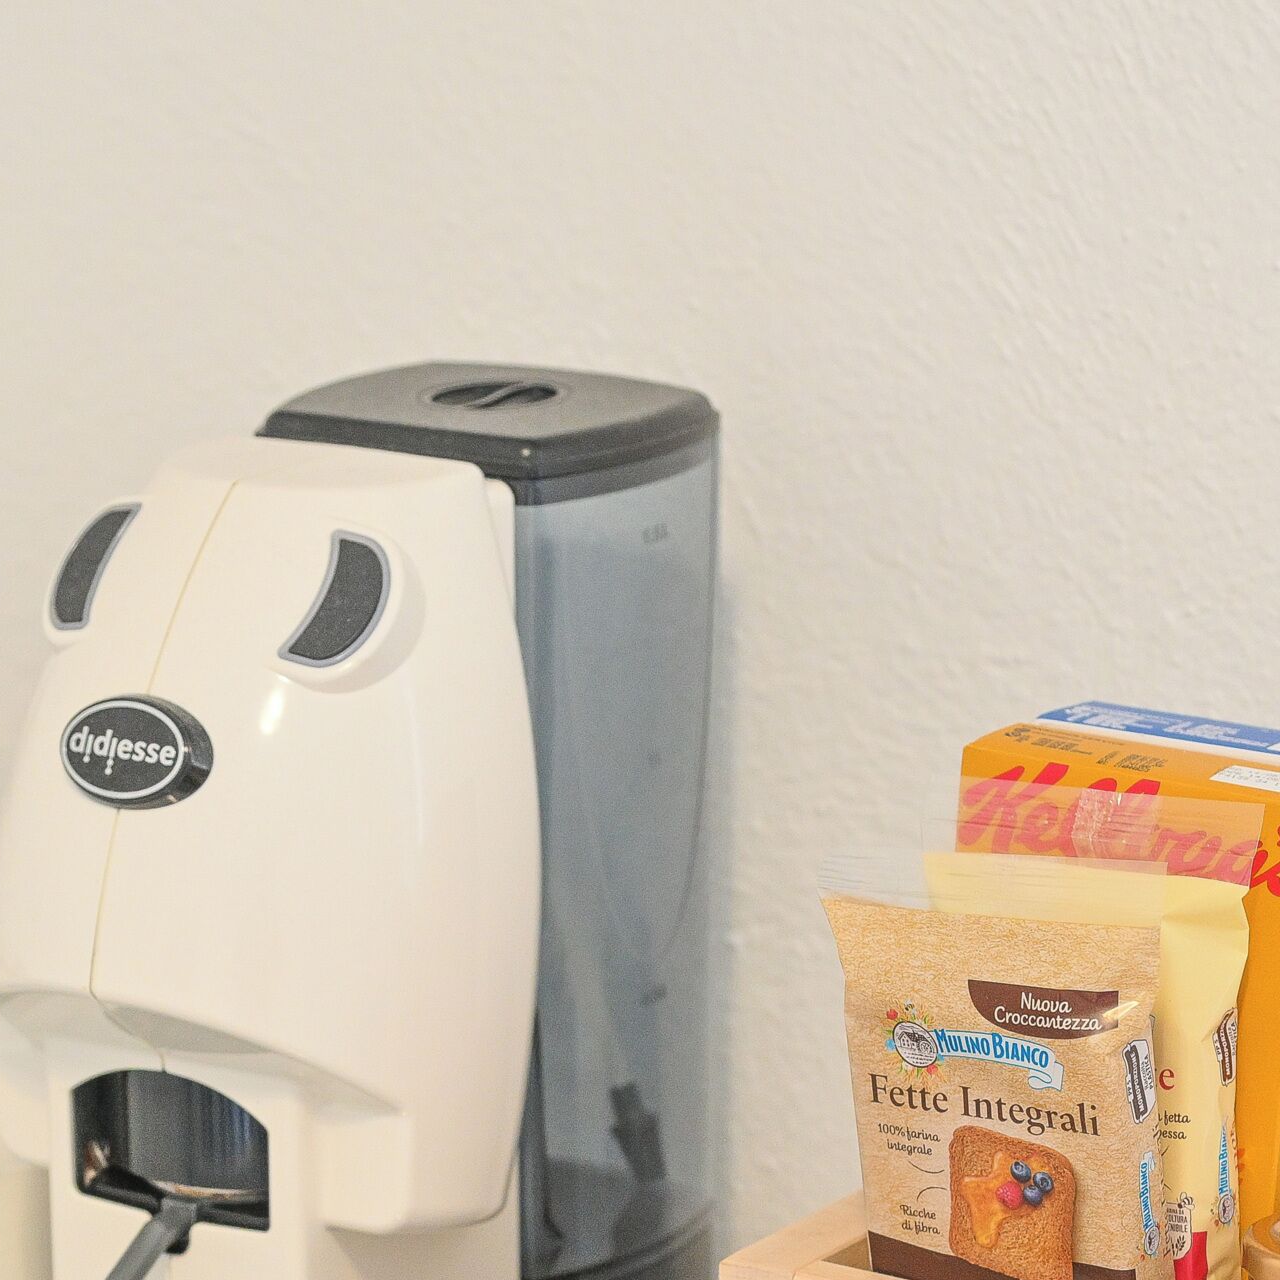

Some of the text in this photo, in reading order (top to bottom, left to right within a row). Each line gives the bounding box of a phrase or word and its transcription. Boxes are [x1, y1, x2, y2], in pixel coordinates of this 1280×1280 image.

[69, 725, 177, 776] didiesse
[1020, 991, 1073, 1014] Nuova
[993, 1006, 1104, 1031] Croccantezza
[933, 1028, 1050, 1069] MULINO BIANCO
[868, 1073, 1101, 1137] Fette Integrali
[878, 1123, 942, 1142] 100% farina
[887, 1139, 933, 1156] integrale
[900, 1204, 937, 1220] Ricche
[902, 1219, 941, 1235] di fibra
